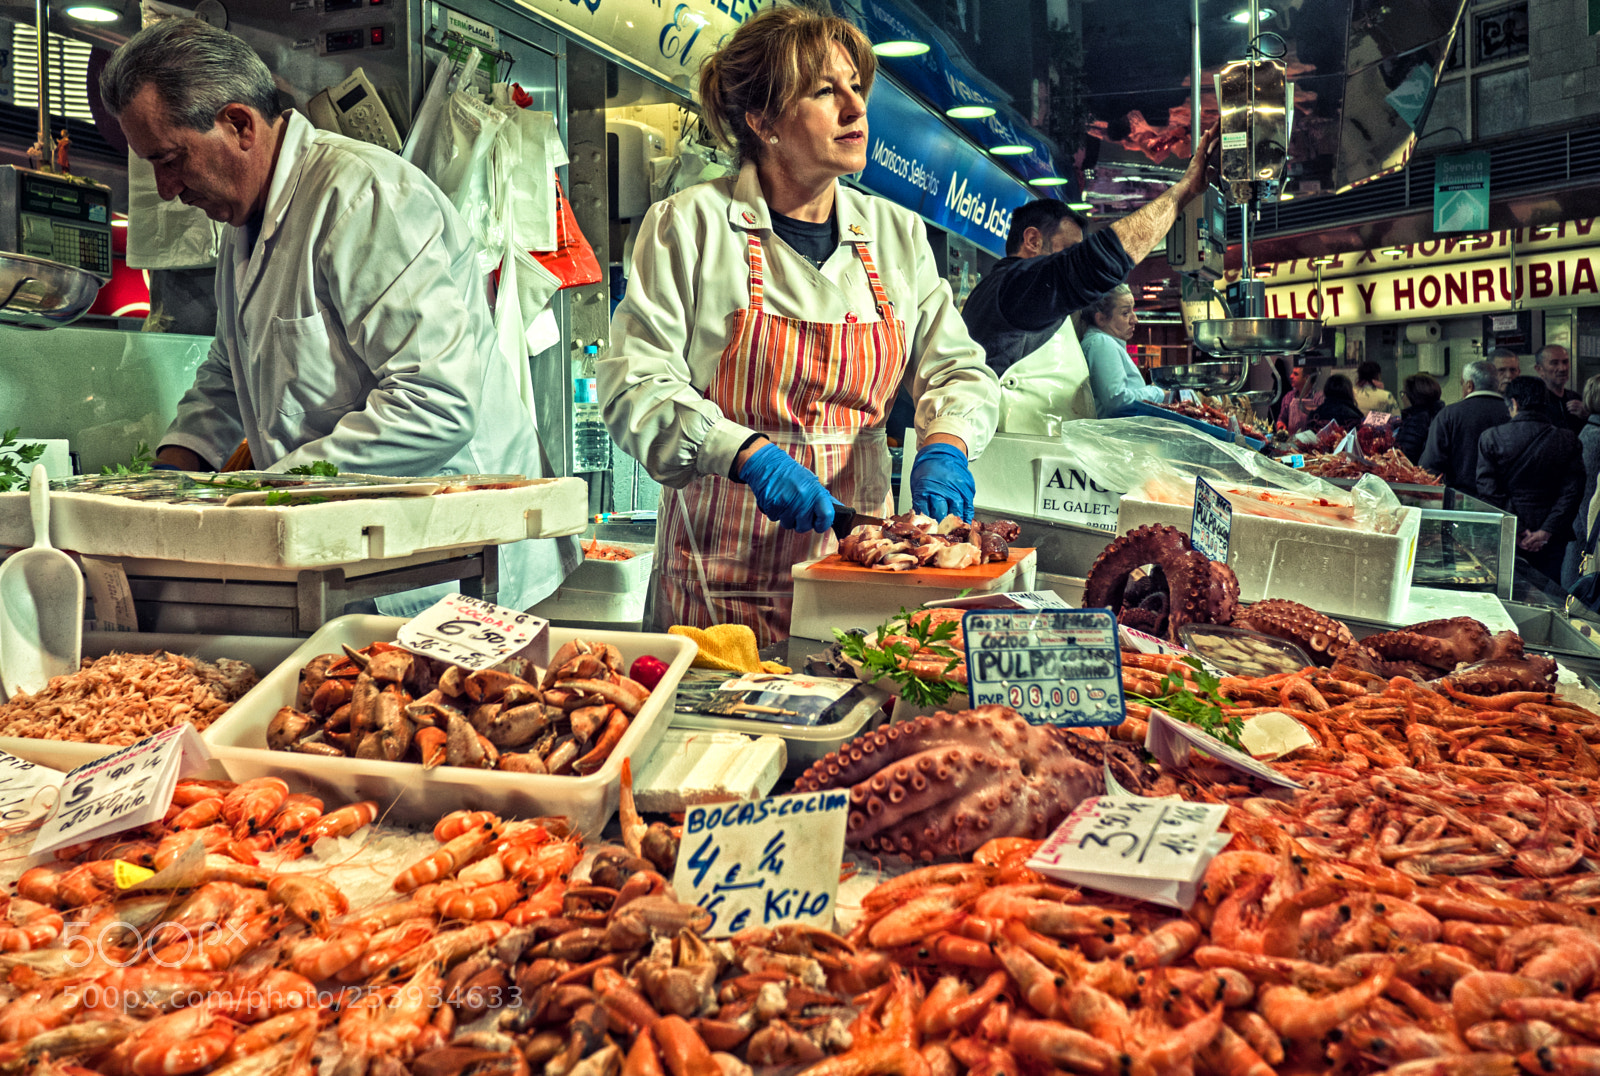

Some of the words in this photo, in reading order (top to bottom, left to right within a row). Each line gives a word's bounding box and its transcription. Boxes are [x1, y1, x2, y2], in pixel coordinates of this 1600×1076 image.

[871, 137, 910, 179] Mariscos
[907, 158, 940, 196] Selectos
[1443, 161, 1475, 173] Servei
[1357, 282, 1377, 314] Y
[1393, 257, 1599, 312] HONRUBIA
[1043, 498, 1060, 511] EL
[457, 605, 515, 633] COCIDAS
[977, 651, 1057, 681] PULPO
[687, 833, 720, 888] 4
